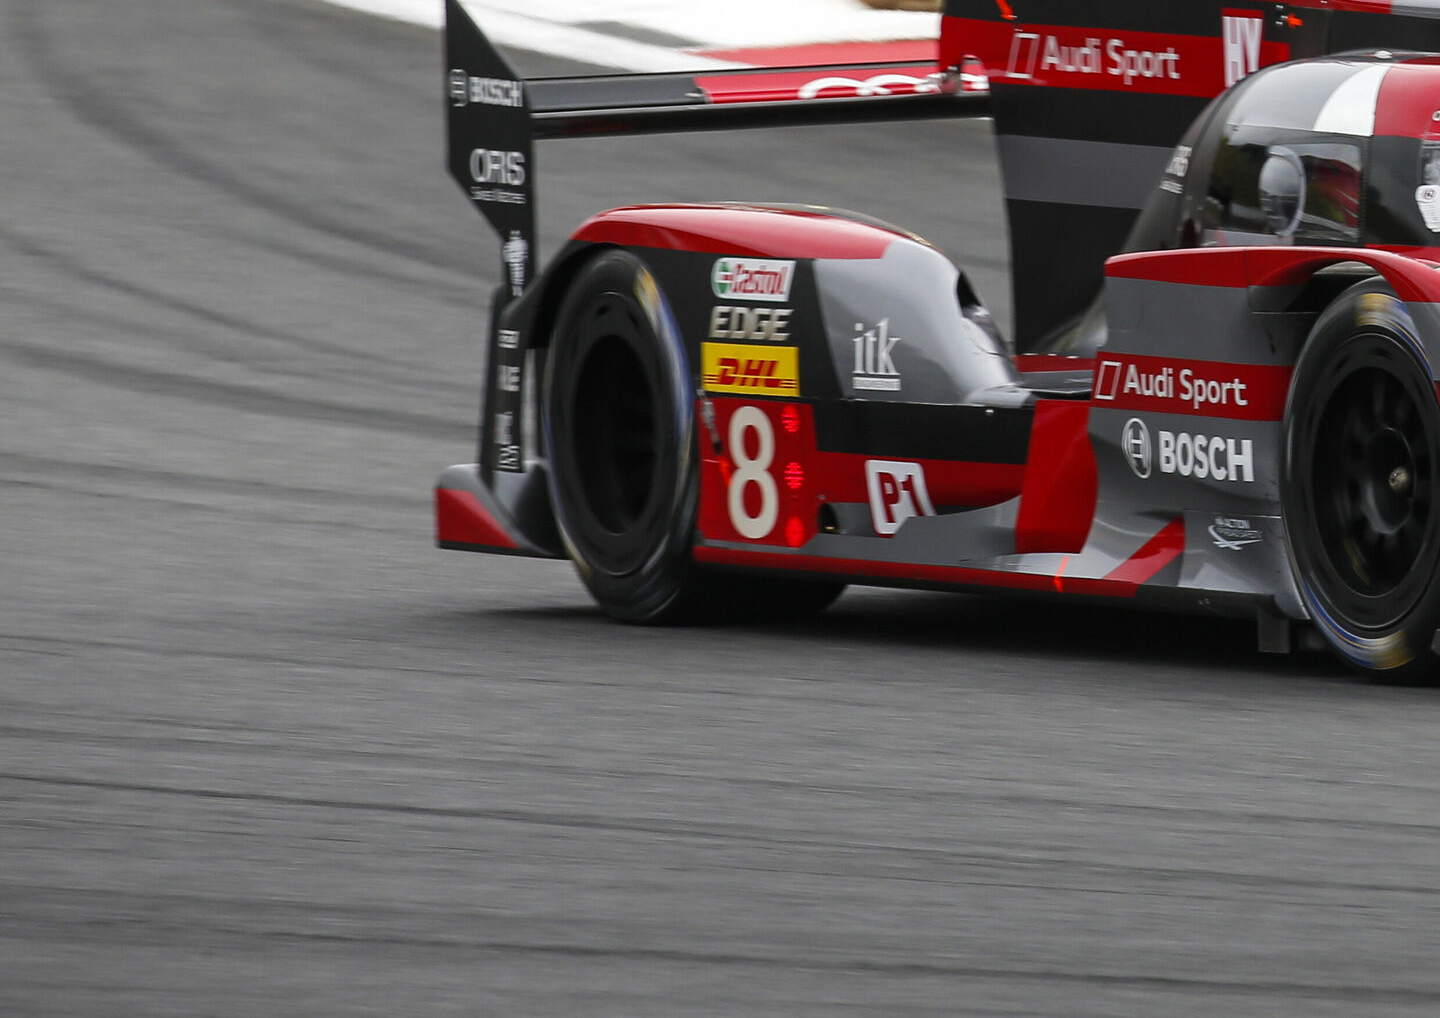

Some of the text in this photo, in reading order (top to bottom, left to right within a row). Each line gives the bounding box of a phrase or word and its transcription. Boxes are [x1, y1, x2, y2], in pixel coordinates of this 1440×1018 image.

[1041, 35, 1180, 85] Audi Sport
[1222, 16, 1263, 88] HY
[709, 305, 795, 340] EDGE
[852, 317, 901, 375] itk
[716, 357, 781, 388] DHL
[1123, 364, 1248, 409] Audi Sport
[727, 405, 779, 539] 8
[1158, 430, 1254, 482] BOSCH
[875, 472, 925, 524] P1
